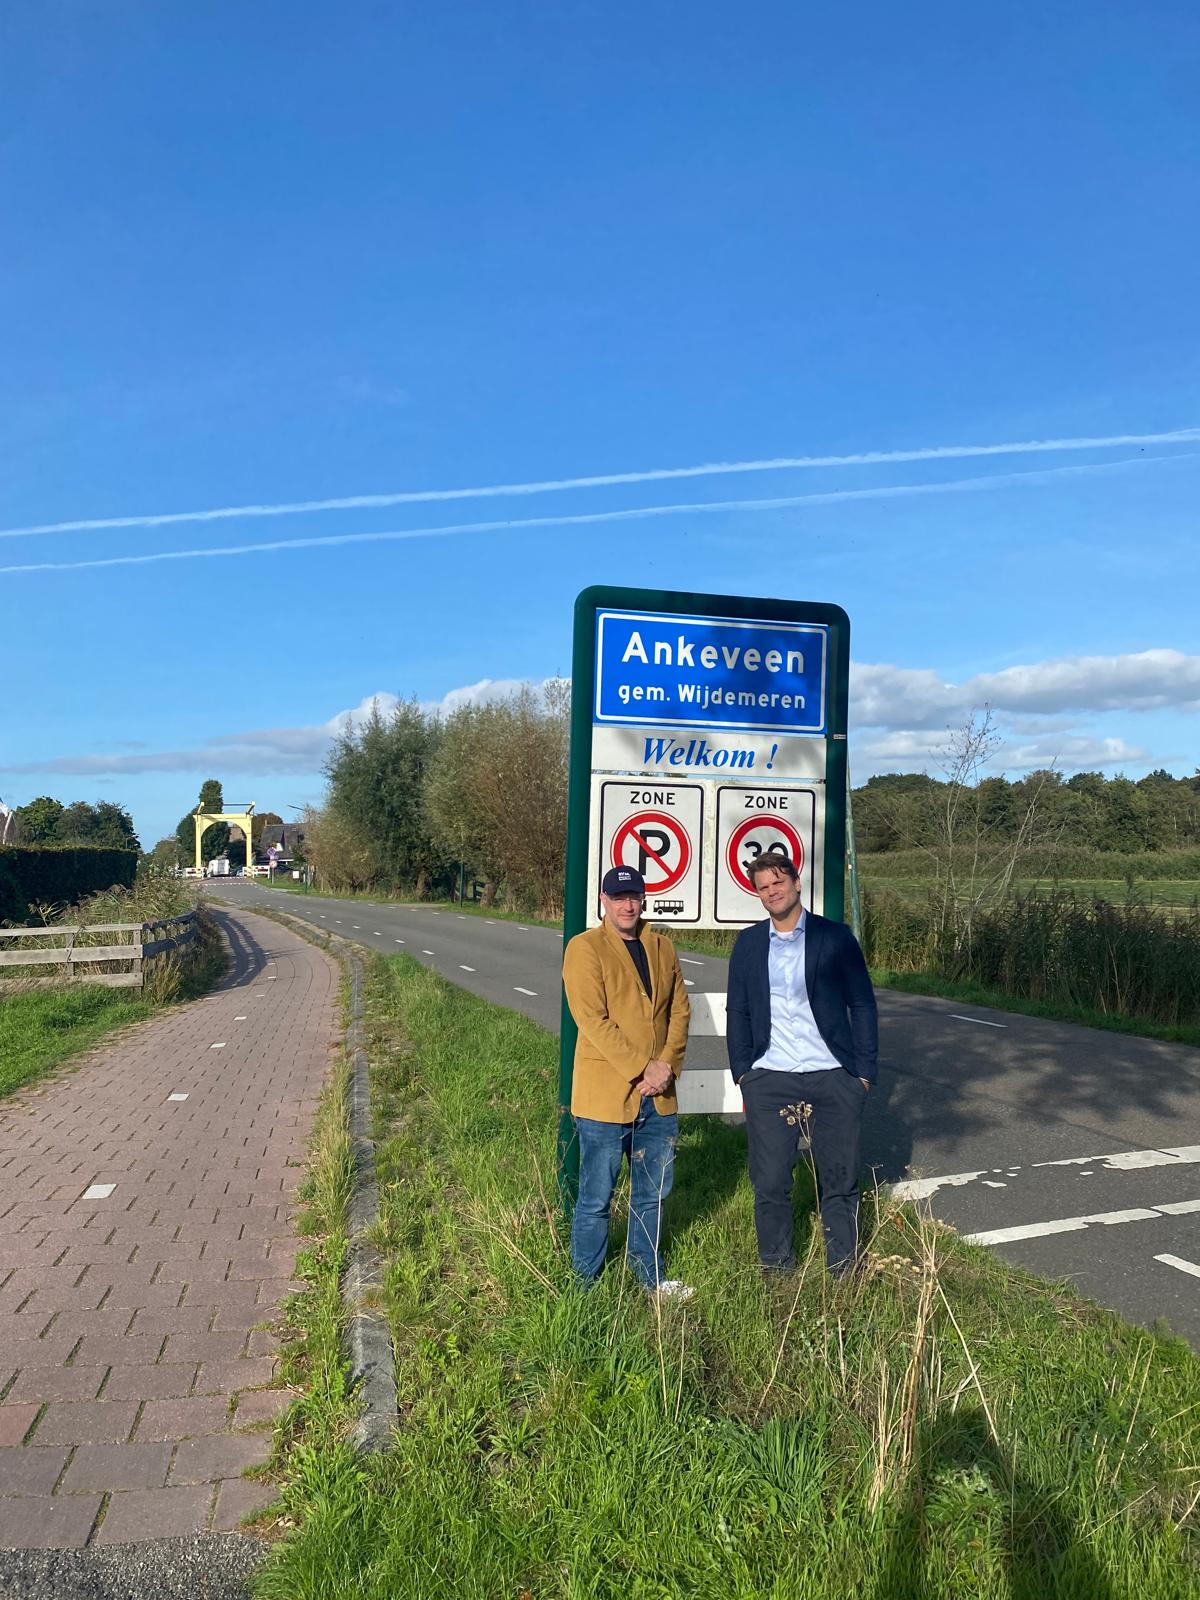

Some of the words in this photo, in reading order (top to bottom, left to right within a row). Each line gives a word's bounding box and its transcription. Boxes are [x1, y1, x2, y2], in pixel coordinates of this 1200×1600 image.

[622, 632, 804, 673] Ankeveen
[618, 684, 670, 704] gem.
[678, 684, 806, 709] Wijdemeren
[643, 737, 755, 768] Welkom
[630, 791, 676, 806] ZONE
[744, 795, 788, 810] ZONE
